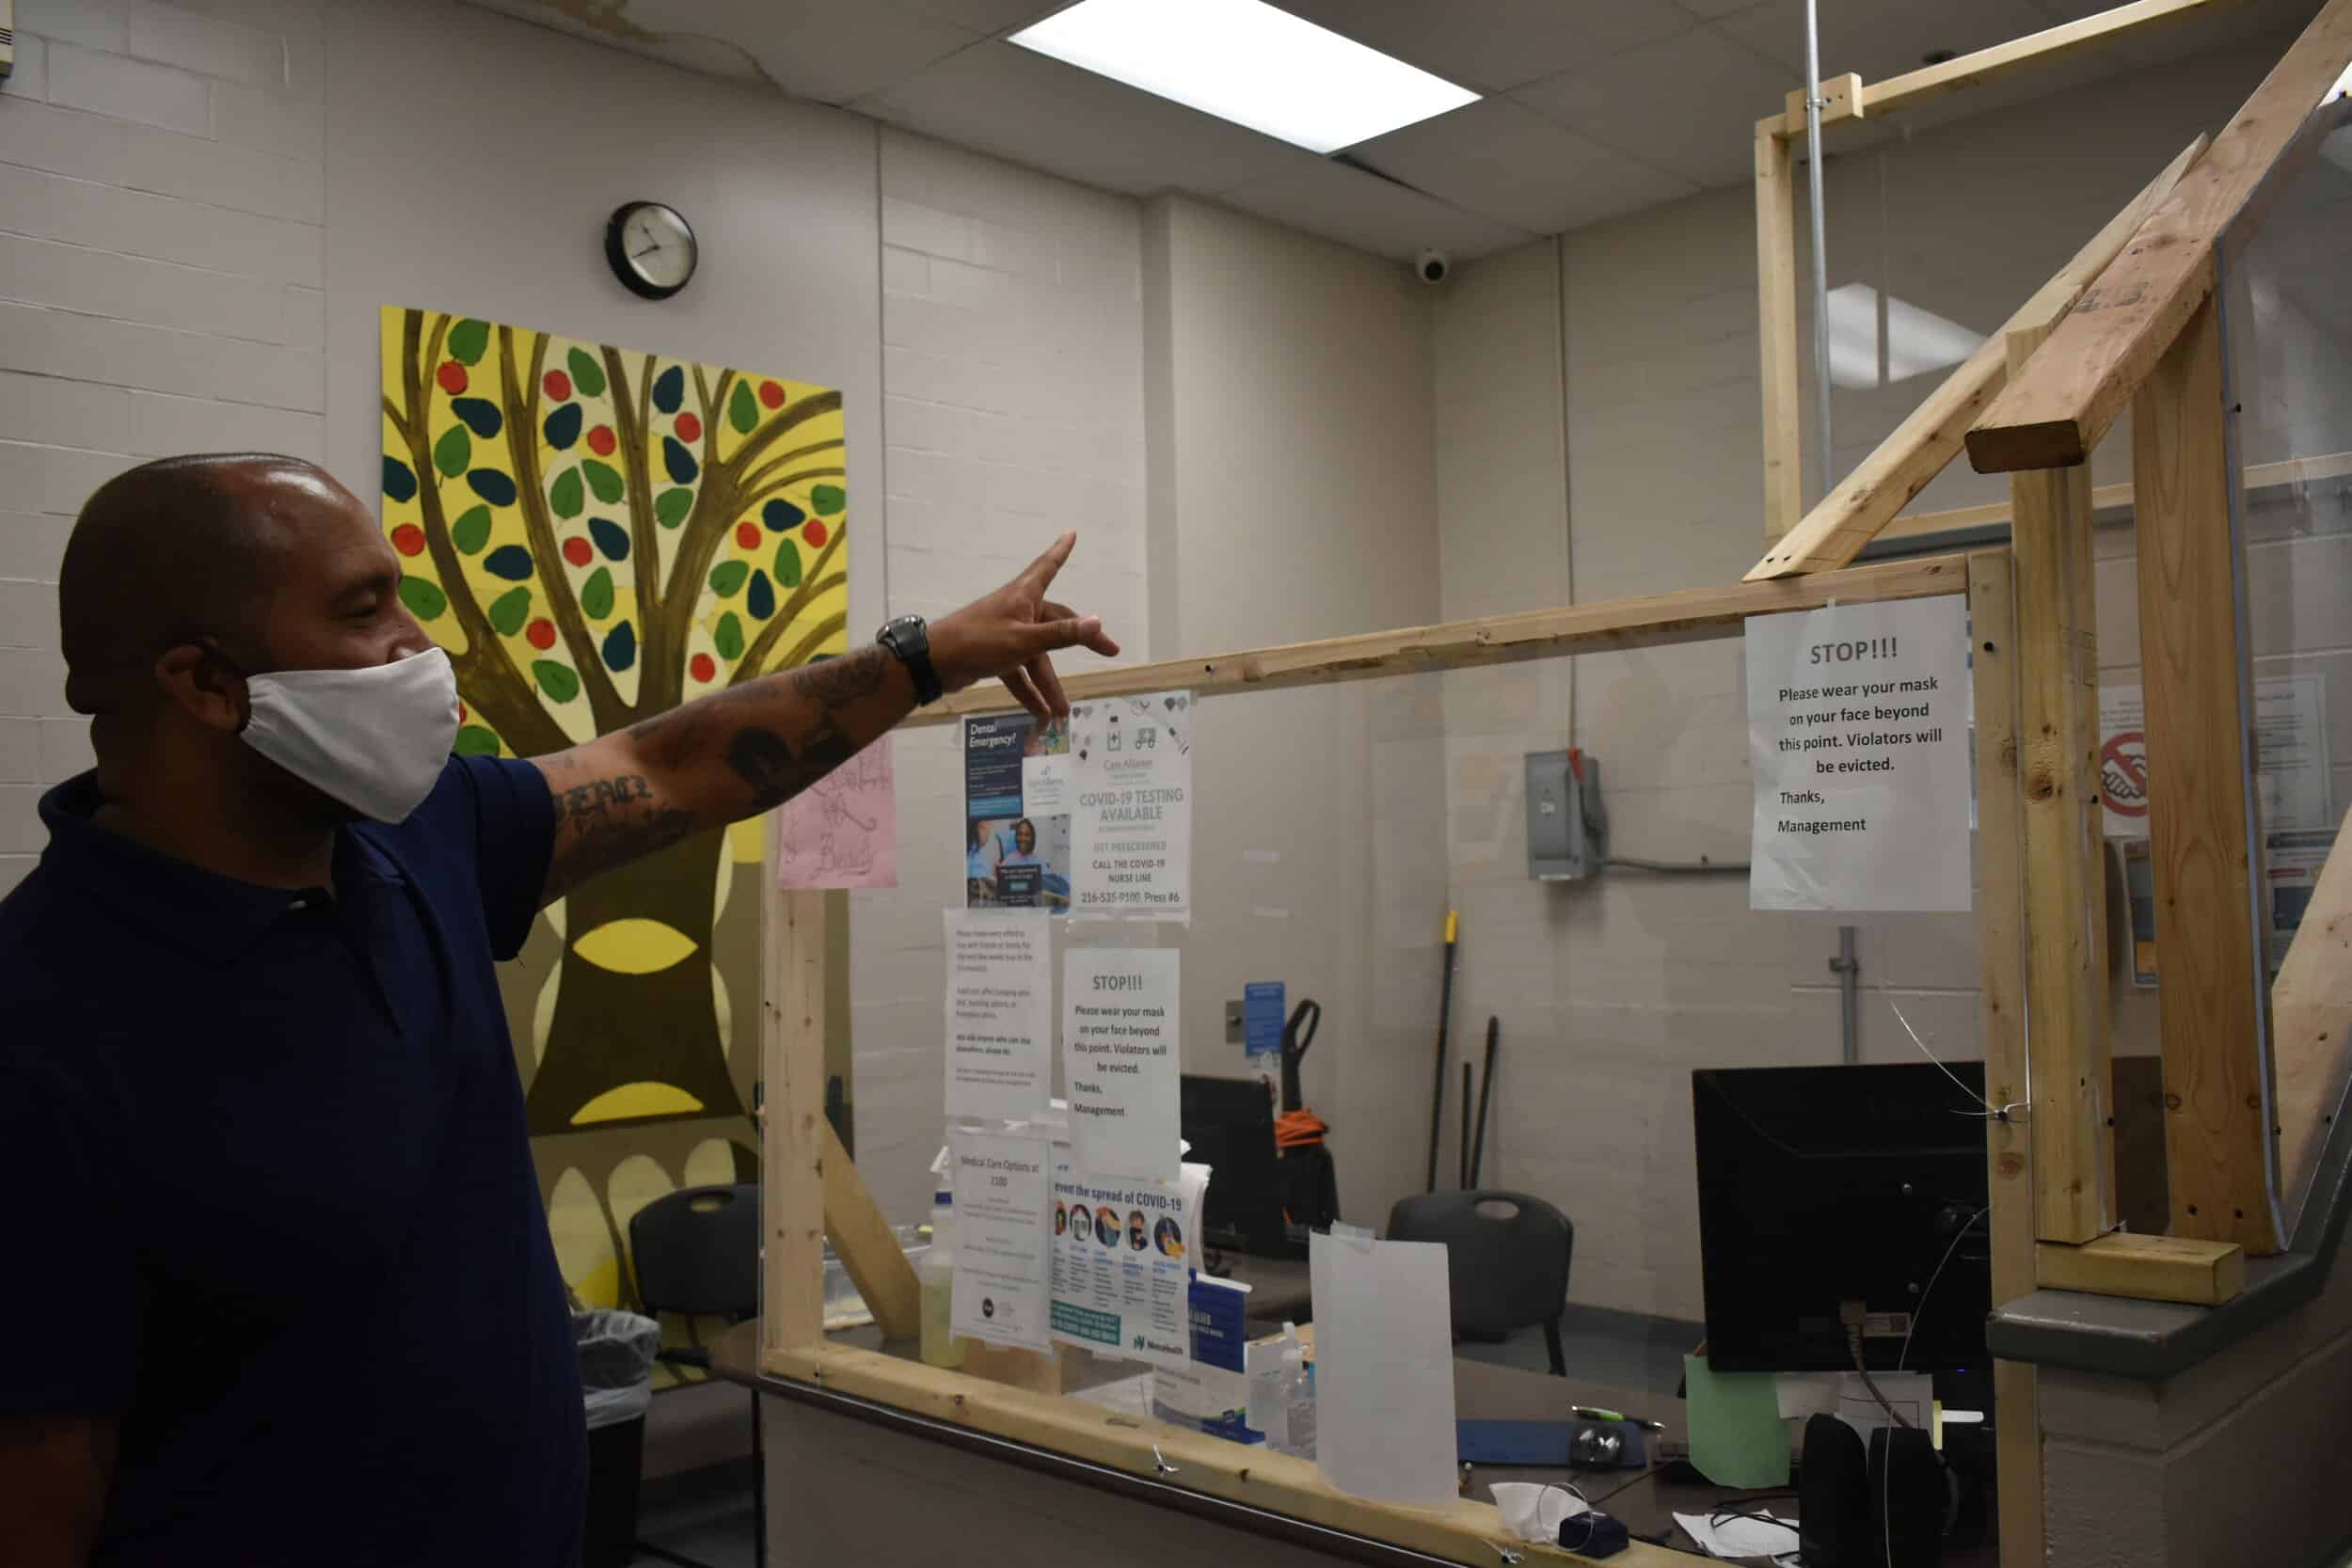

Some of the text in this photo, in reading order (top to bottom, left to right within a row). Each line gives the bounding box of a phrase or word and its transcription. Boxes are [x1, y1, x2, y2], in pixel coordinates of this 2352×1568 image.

[1810, 636, 1899, 664] STOP!!!
[1779, 676, 1939, 703] Please wear your mask
[1789, 703, 1930, 727] on your face beyond
[970, 722, 997, 736] Dental
[969, 733, 1017, 749] Emergency?
[1779, 728, 1943, 752] this point. Violators will
[1817, 757, 1896, 774] be evicted.
[1079, 790, 1133, 806] COVID-19
[1136, 787, 1184, 804] TESTING
[1780, 790, 1826, 806] Thanks,
[1100, 805, 1164, 821] AVAILABLE
[1778, 817, 1867, 834] Management
[1092, 858, 1167, 870] CALL THE COVID-19
[1108, 873, 1152, 883] NURSE LINE
[1144, 892, 1168, 903] Press
[1092, 974, 1143, 991] STOP!!!
[1075, 1005, 1165, 1020] Please wear your mask
[1090, 1025, 1108, 1037] your
[1110, 1023, 1127, 1036] face
[1129, 1024, 1160, 1037] beyond
[1074, 1042, 1168, 1055] this point. Violators will
[1097, 1060, 1140, 1074] be evicted.
[1074, 1102, 1125, 1117] Management
[1091, 1189, 1122, 1204] spread
[1124, 1191, 1135, 1204] of
[1136, 1192, 1182, 1212] COVID-19
